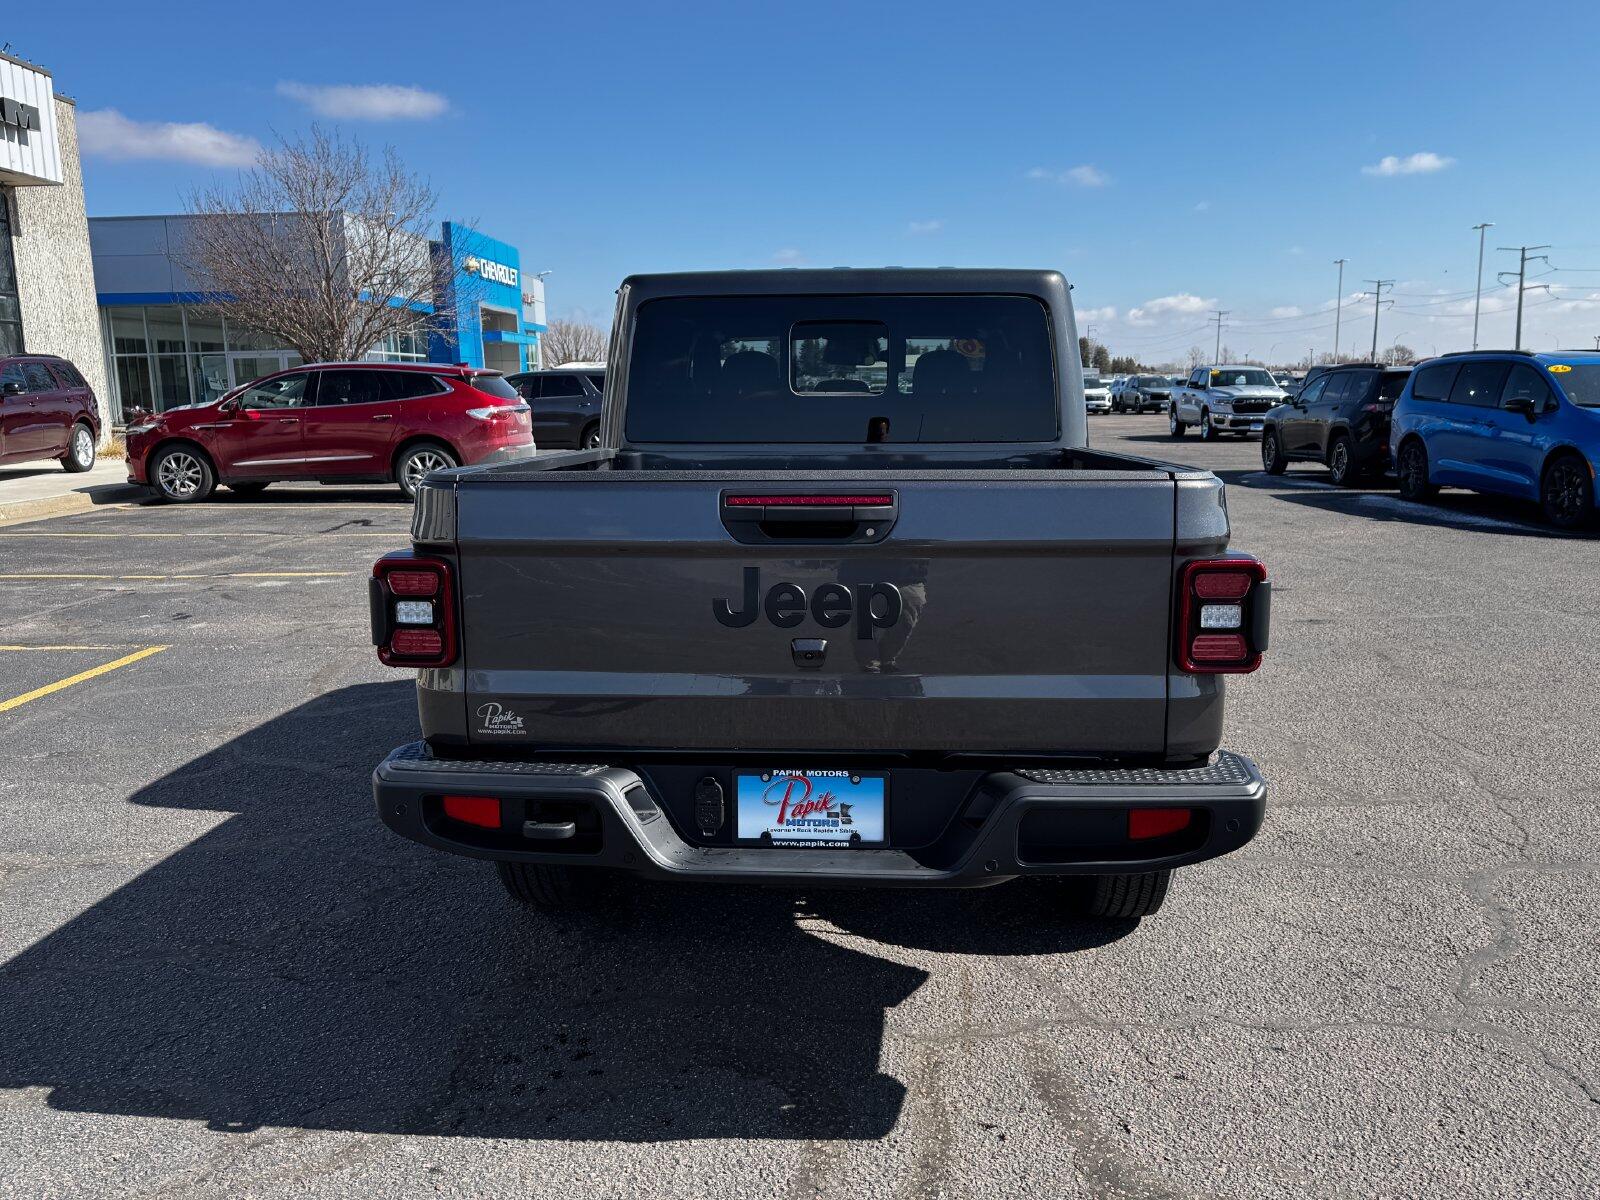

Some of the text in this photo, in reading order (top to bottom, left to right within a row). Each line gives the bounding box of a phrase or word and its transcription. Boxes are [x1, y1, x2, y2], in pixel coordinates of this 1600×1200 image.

[480, 259, 518, 286] CHEVROLET
[712, 566, 903, 640] Jeep
[477, 703, 516, 727] Papik
[772, 769, 804, 777] PAPIK
[763, 776, 839, 825] Papik
[785, 818, 839, 827] MOTORS
[772, 840, 850, 848] www.papik.com
